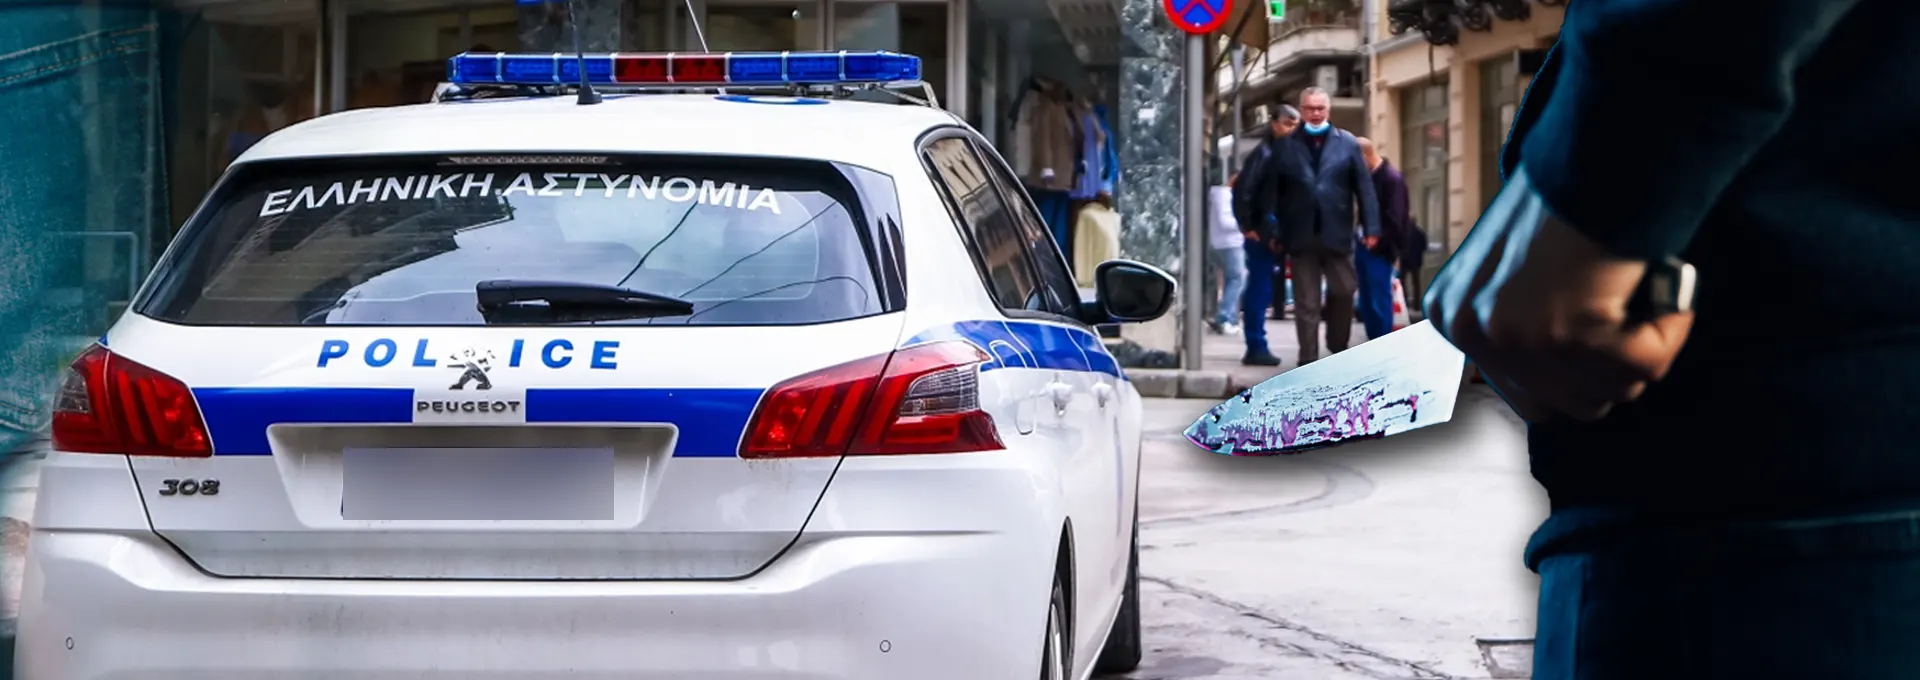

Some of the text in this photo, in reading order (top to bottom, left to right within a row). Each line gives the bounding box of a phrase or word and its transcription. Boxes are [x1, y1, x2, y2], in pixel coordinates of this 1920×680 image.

[259, 172, 783, 217] ΕΛΛΗΝΙΚΗ ΑΣΤΥΝΟΜΙΑ
[317, 338, 620, 370] POLICE
[416, 400, 521, 414] PEUGEOT
[158, 478, 220, 497] 308
